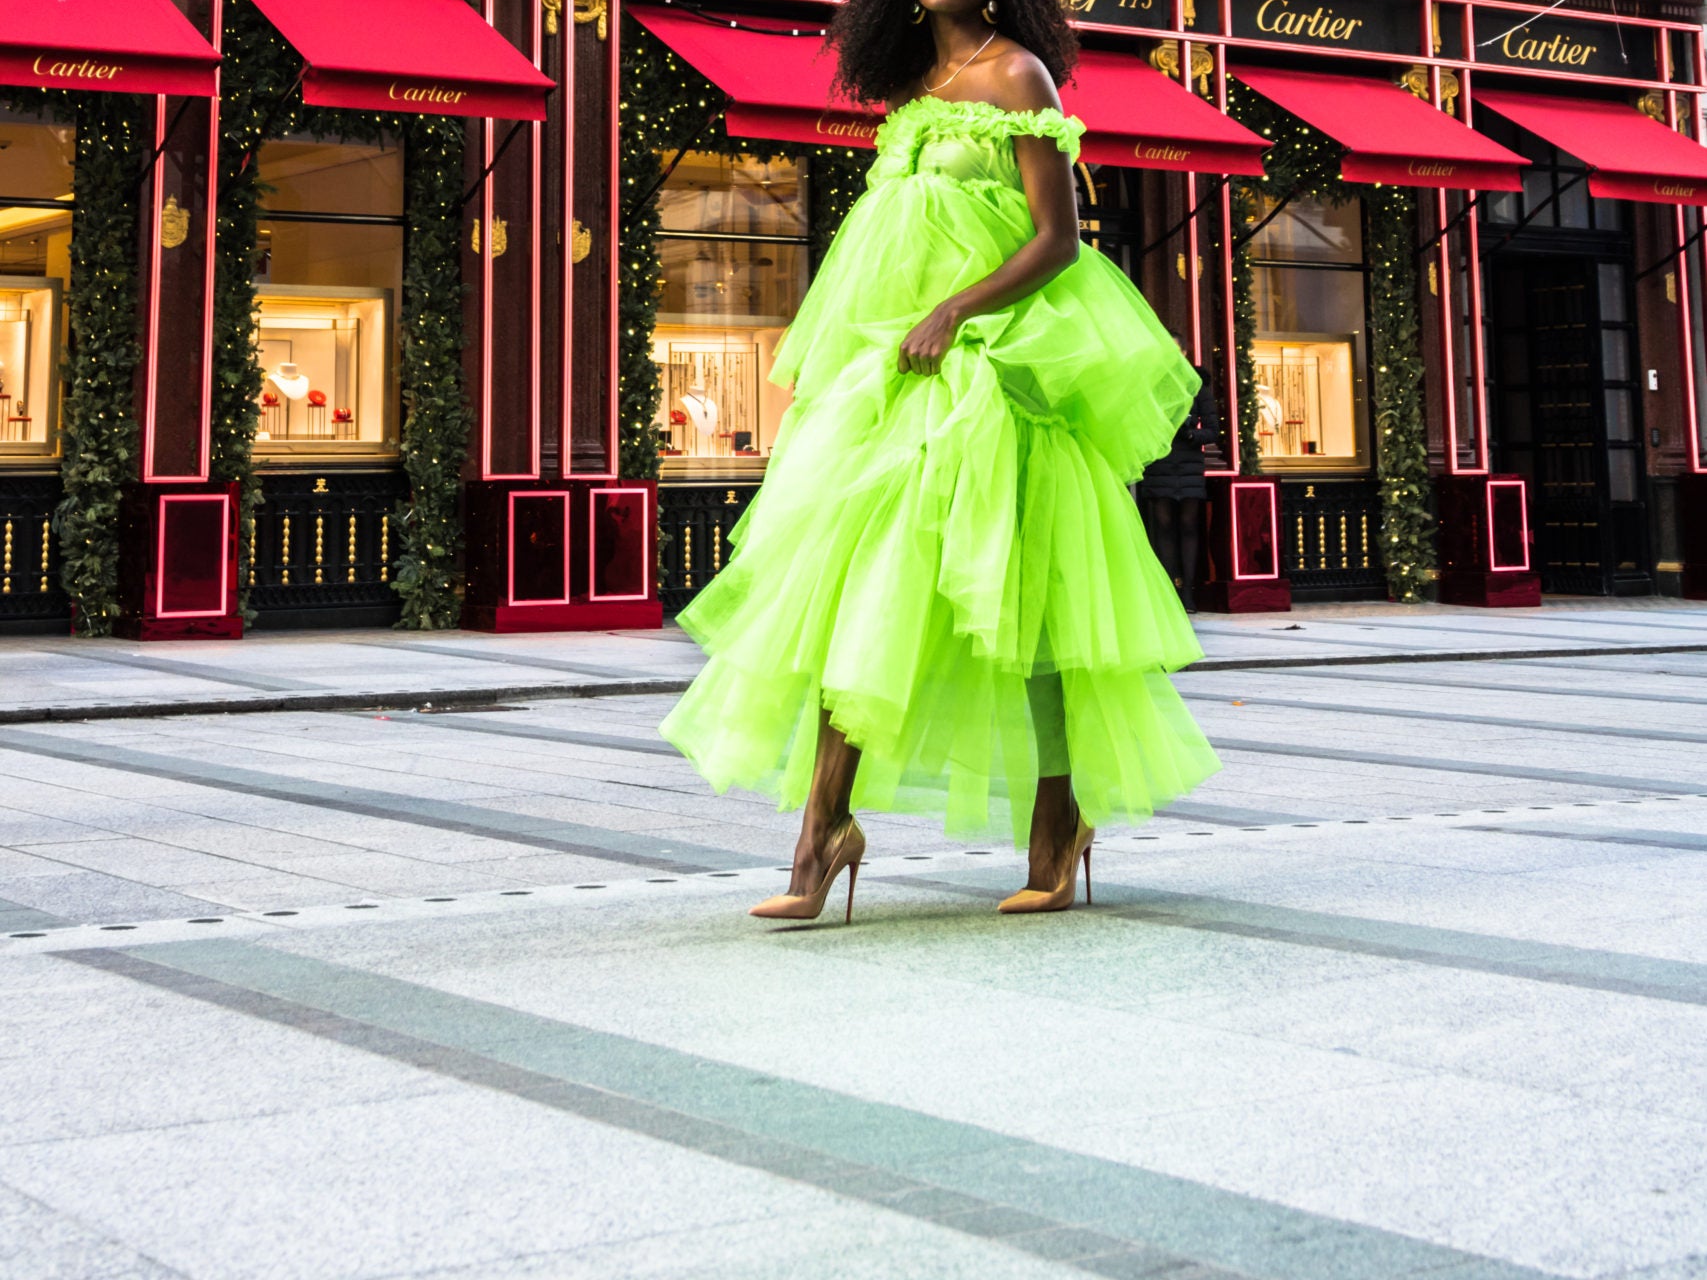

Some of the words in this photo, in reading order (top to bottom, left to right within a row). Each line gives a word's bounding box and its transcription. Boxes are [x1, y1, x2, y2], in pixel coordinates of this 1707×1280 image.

[1502, 25, 1598, 66] Cartier
[33, 53, 124, 79] Cartier
[389, 80, 467, 104] Cartier
[1135, 141, 1191, 161] Cartier
[1408, 160, 1456, 177] Cartier
